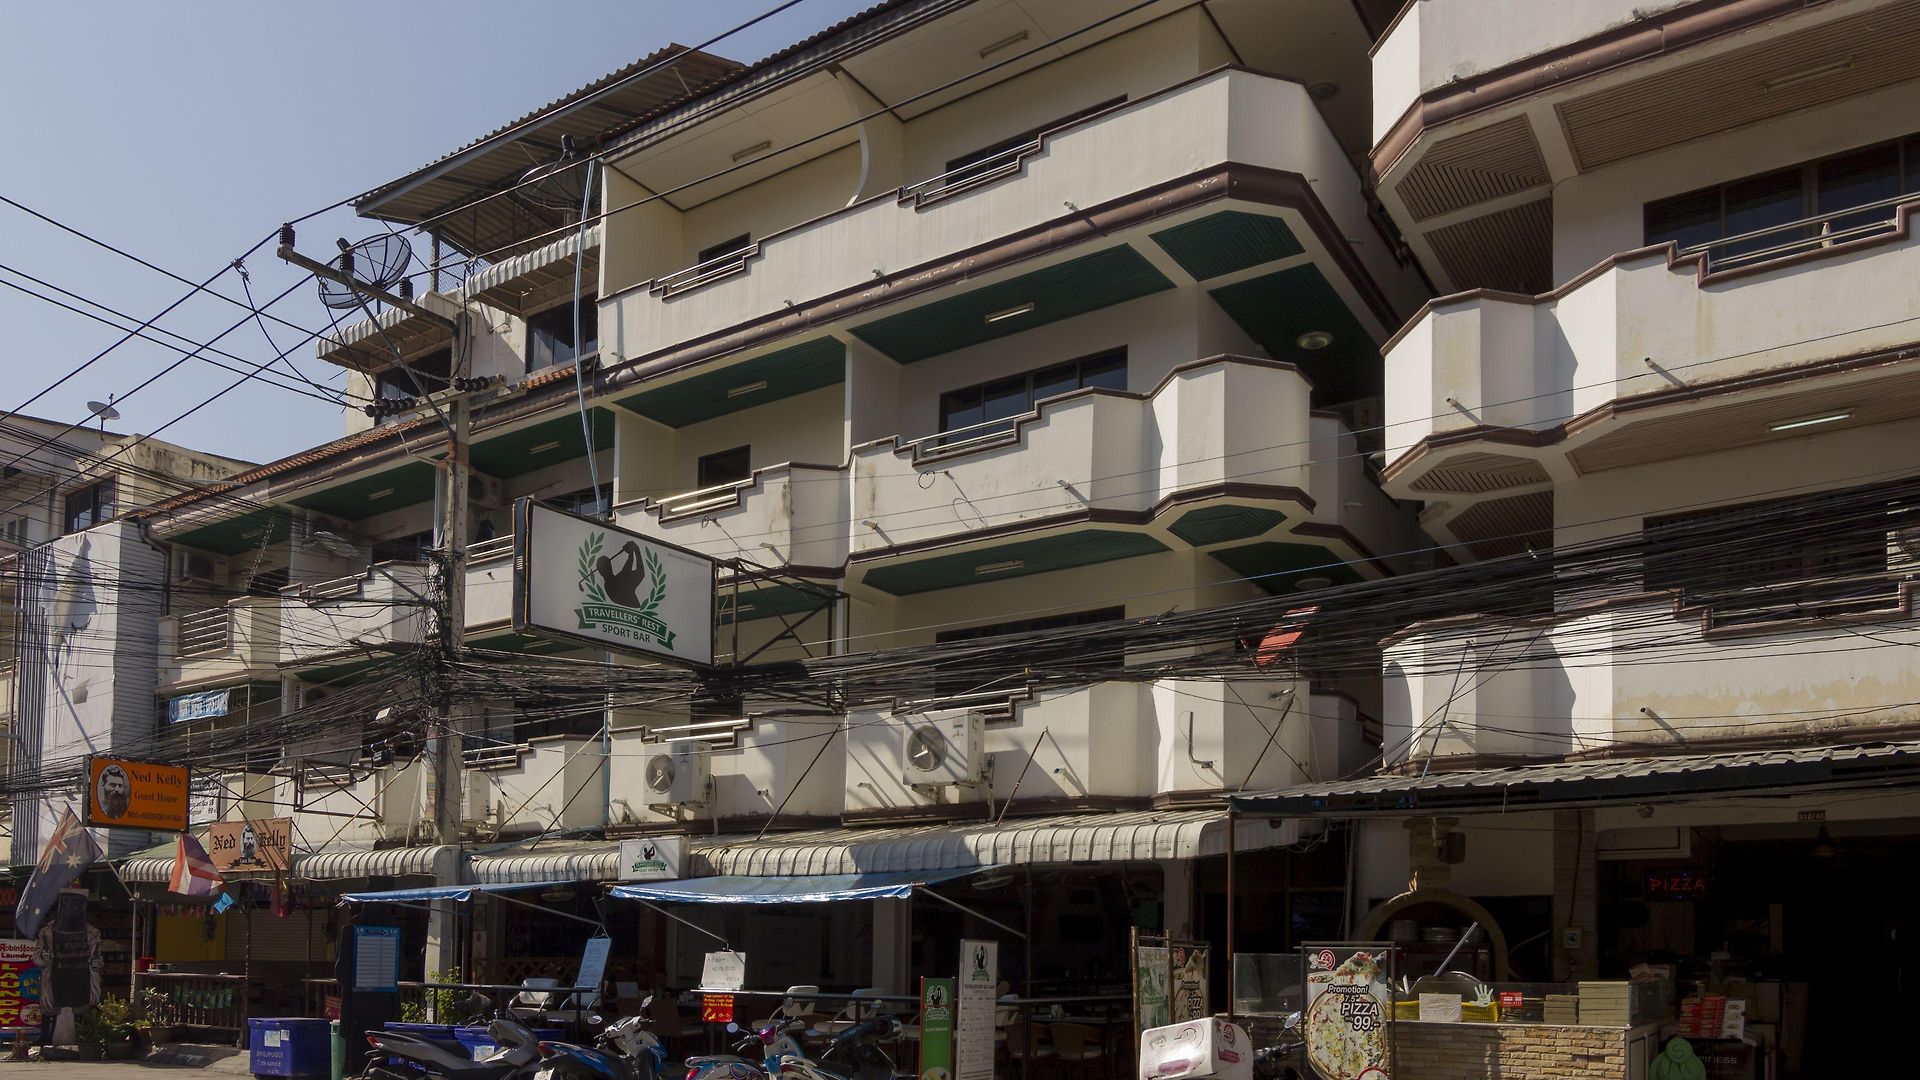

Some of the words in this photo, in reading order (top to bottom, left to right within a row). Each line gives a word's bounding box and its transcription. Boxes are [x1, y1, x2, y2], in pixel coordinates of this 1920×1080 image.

[588, 607, 640, 624] TRAVELLERS'
[642, 619, 661, 632] REST
[602, 624, 631, 638] SPORT
[633, 631, 651, 643] BAR
[131, 770, 151, 783] Ned
[156, 772, 182, 788] Kelly
[134, 791, 155, 801] Guest
[157, 792, 178, 803] House
[212, 834, 237, 854] Ned
[258, 829, 286, 853] Kelly
[1650, 878, 1705, 891] PIZZA
[0, 943, 35, 952] RobinHoo
[1327, 984, 1370, 994] Promotion!
[1341, 1003, 1379, 1015] PIZZA
[1353, 1016, 1380, 1030] 99.-
